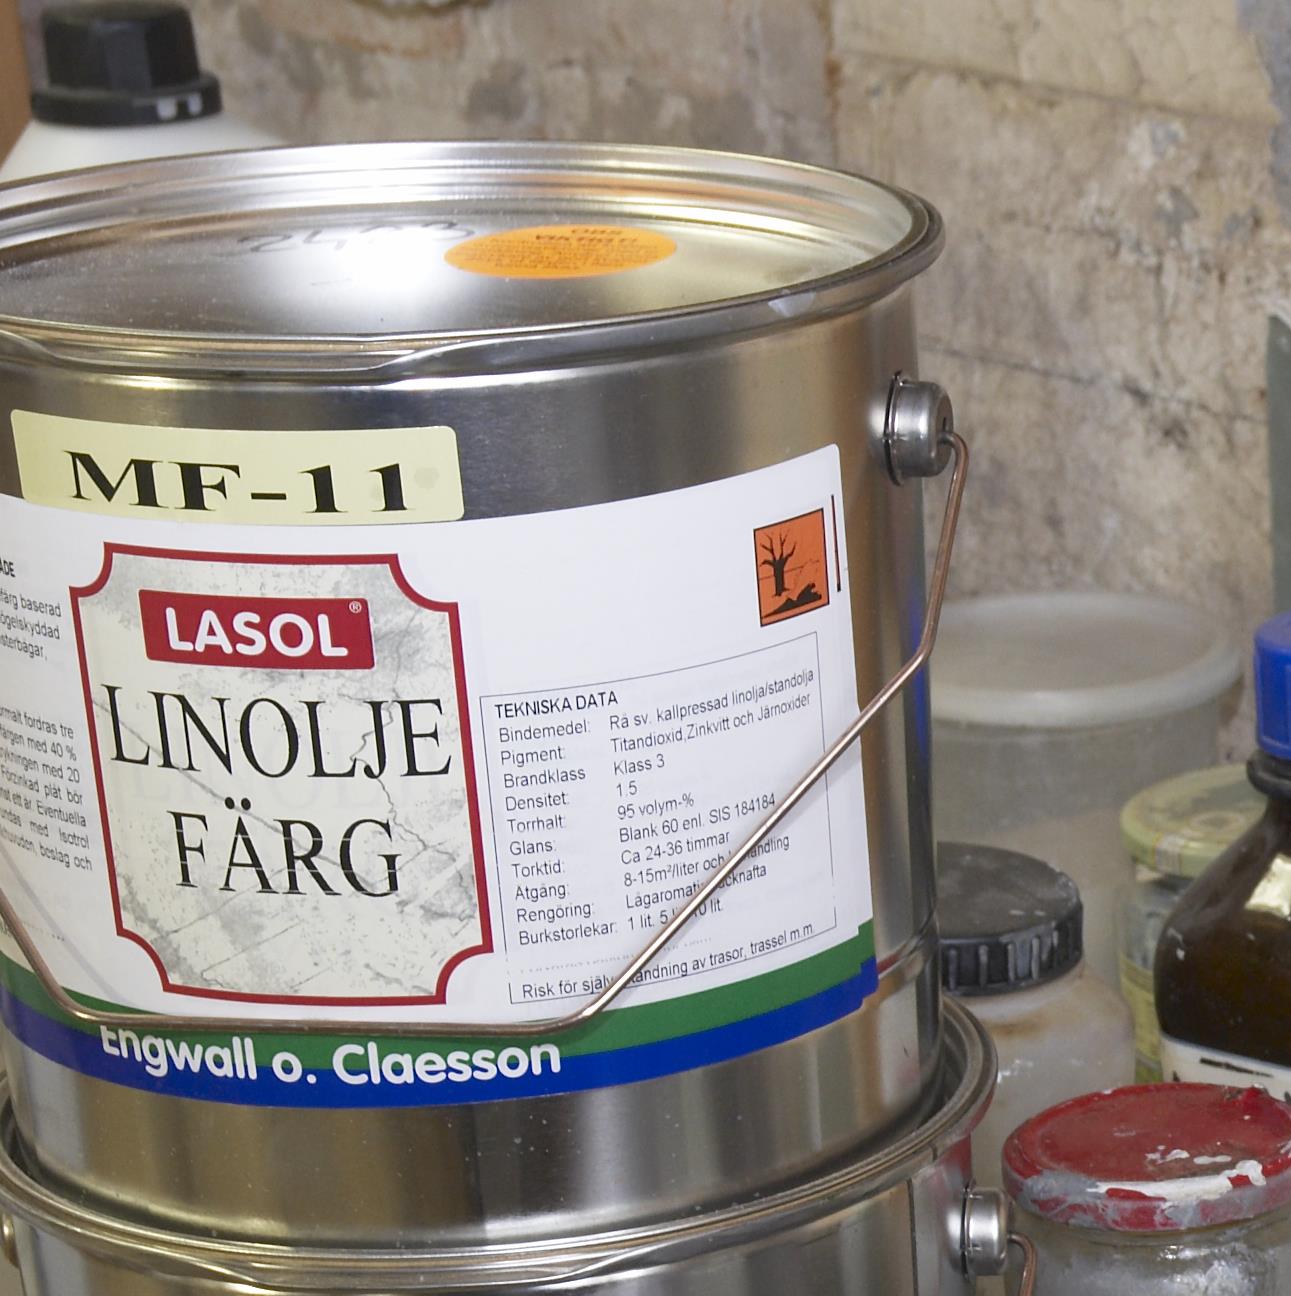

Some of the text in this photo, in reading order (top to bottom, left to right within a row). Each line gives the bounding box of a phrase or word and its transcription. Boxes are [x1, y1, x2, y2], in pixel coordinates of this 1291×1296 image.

[64, 450, 415, 513] MF-11
[20, 594, 61, 617] baserad
[165, 607, 348, 657] LASOL
[495, 691, 618, 719] TEKNISKA DATA
[499, 721, 591, 743] Bindemedel:
[656, 693, 728, 723] kallpressad
[732, 668, 814, 706] linolja/standolja
[24, 712, 73, 739] fordras tre
[102, 684, 451, 779] LINOLJE
[501, 747, 566, 766] Pigment:
[733, 712, 754, 728] och
[757, 693, 811, 722] Järnoxider
[27, 737, 47, 753] med
[51, 742, 63, 758] 40
[42, 763, 80, 783] med 20
[504, 754, 665, 788] Brandklass Klass 3
[37, 801, 86, 827] Eventuella
[506, 792, 569, 812] Densitet:
[508, 793, 694, 833] Torrhalt: 95 volym-%
[30, 820, 48, 837] med
[510, 840, 556, 856] Glans:
[620, 822, 658, 842] Blank
[662, 818, 679, 833] 60
[709, 805, 731, 823] SIS
[734, 793, 776, 820] 184184
[74, 856, 92, 870] och
[167, 797, 402, 897] FÄRG
[512, 831, 730, 878] Torktid: Ca 24-36 timmar
[703, 854, 725, 871] och
[518, 903, 594, 924] Rengöring:
[519, 922, 617, 946] Burkstorlekar:
[628, 916, 634, 931] 1
[660, 909, 668, 924] 5
[523, 929, 786, 998] Risk för av trasor, trassel
[101, 1025, 561, 1085] Engwall o. Claesson
